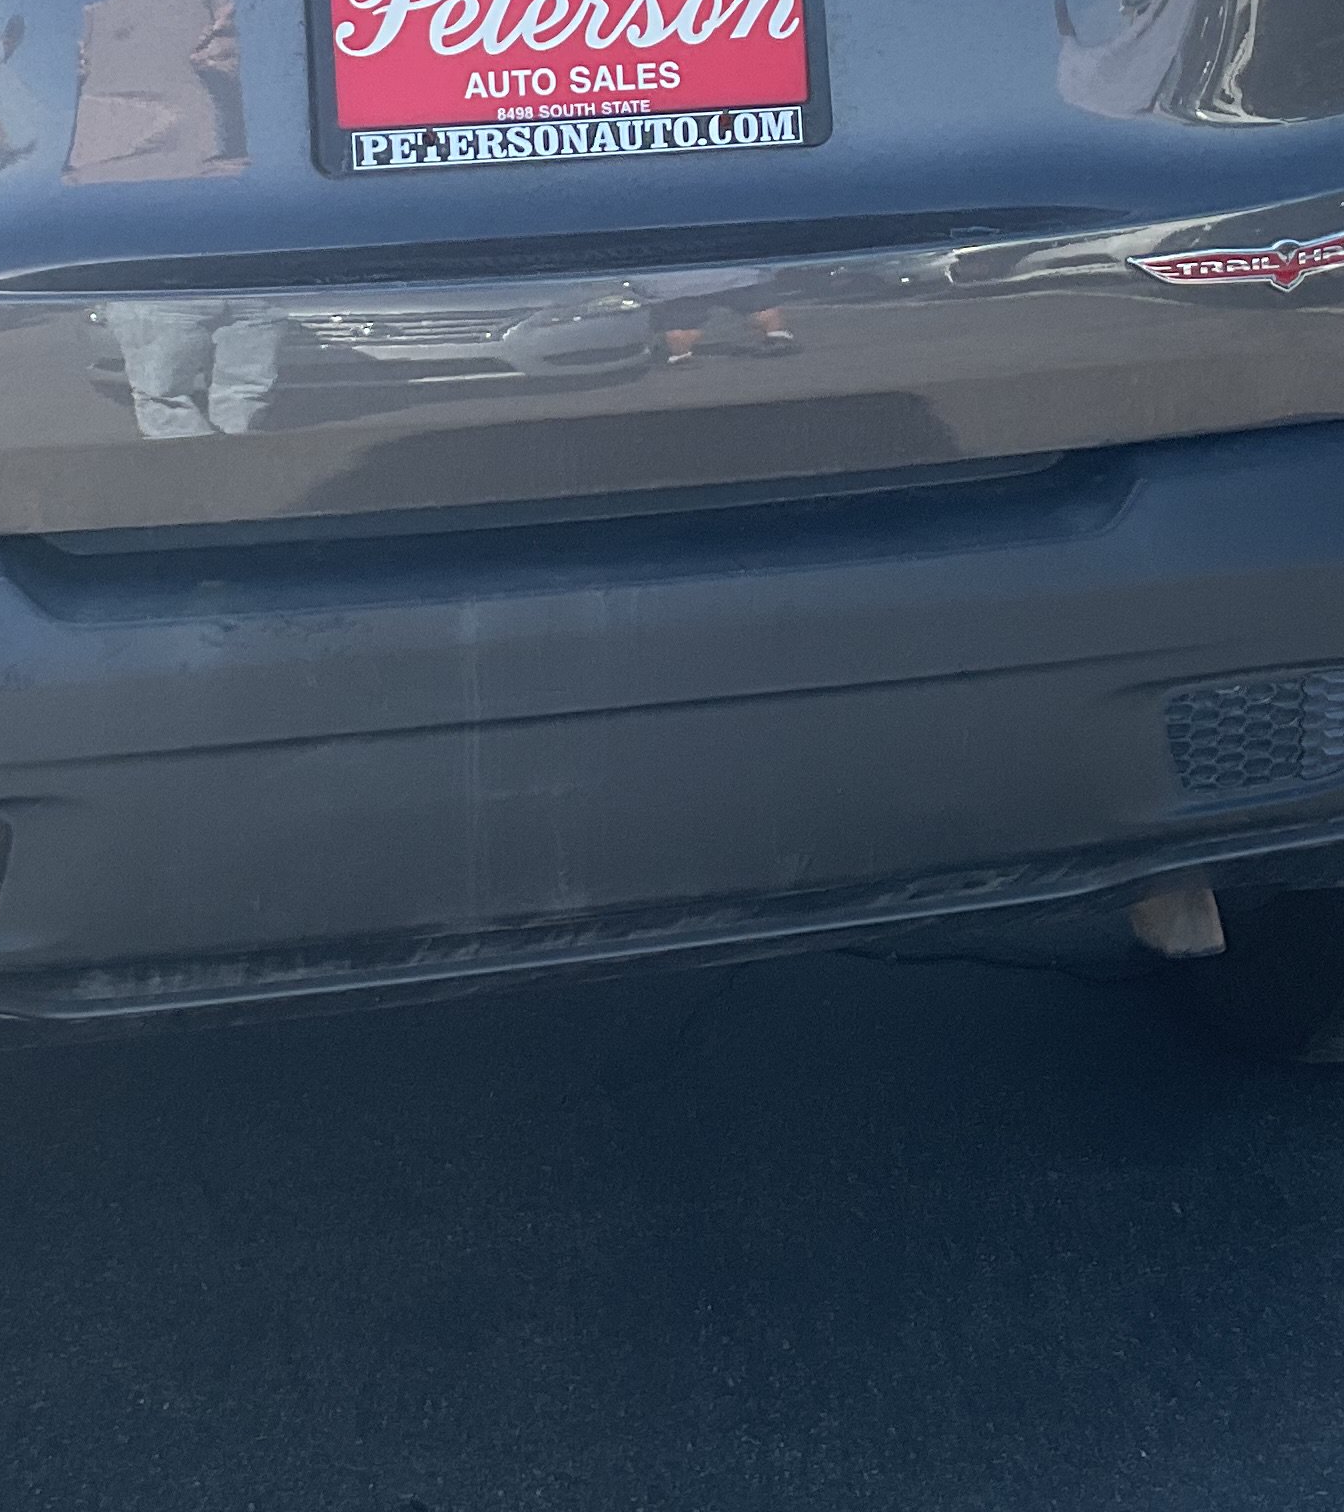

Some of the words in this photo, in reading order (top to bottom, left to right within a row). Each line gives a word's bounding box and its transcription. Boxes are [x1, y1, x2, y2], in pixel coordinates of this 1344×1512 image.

[464, 68, 556, 100] AUTO
[569, 61, 681, 93] SALES
[497, 106, 534, 121] 8498
[539, 102, 597, 119] SOUTH
[601, 99, 651, 116] STATE
[359, 109, 796, 166] PETERSONAUTO.COM
[1175, 256, 1280, 277] TRAIL
